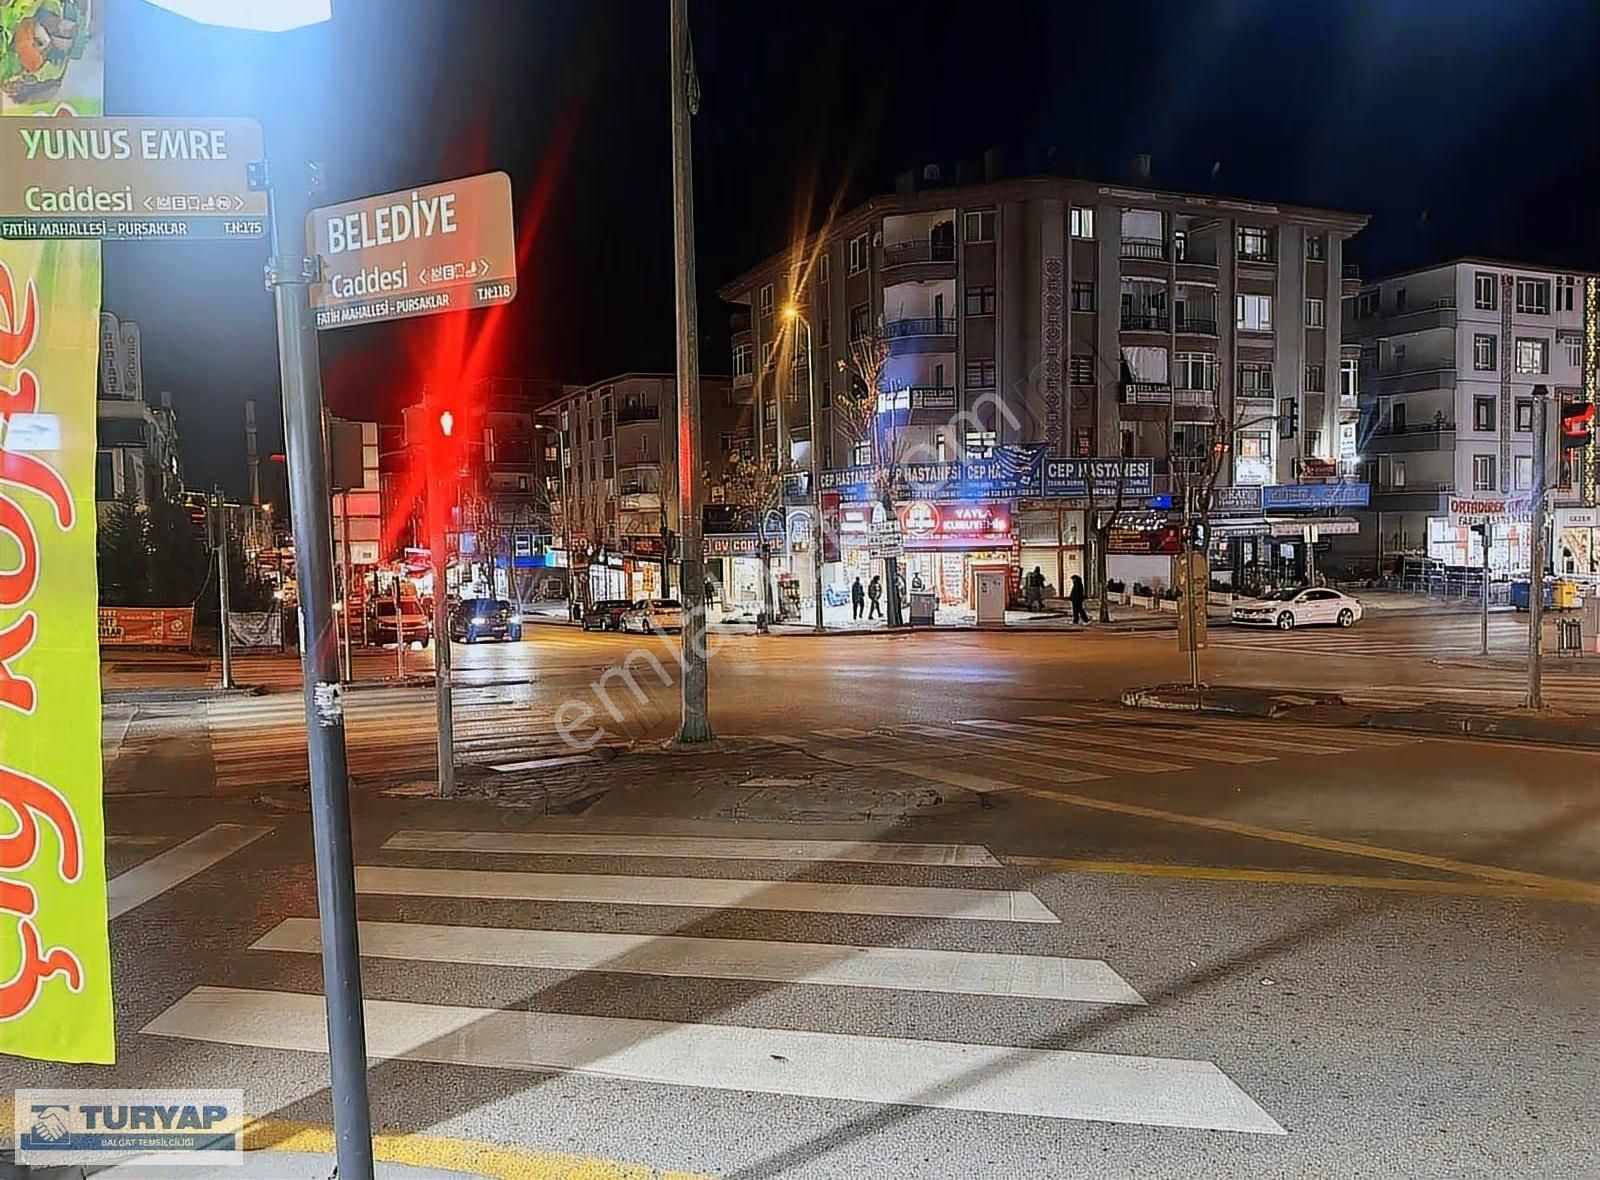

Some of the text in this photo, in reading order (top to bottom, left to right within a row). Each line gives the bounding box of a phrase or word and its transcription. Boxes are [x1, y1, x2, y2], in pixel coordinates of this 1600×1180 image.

[20, 129, 229, 160] YUNUS EMRE
[25, 185, 133, 212] Caddesi
[3, 220, 37, 236] FATİH
[40, 220, 106, 236] MAHALLESİ
[118, 222, 187, 236] PURSAKLAR
[328, 191, 457, 253] BELEDİYE
[332, 261, 409, 298] Caddesi
[317, 309, 341, 326] FATİH
[341, 299, 389, 323] MAHALLESİ
[396, 294, 450, 313] PURSAKLAR
[967, 463, 986, 479] CEP
[1048, 463, 1074, 478] CEP
